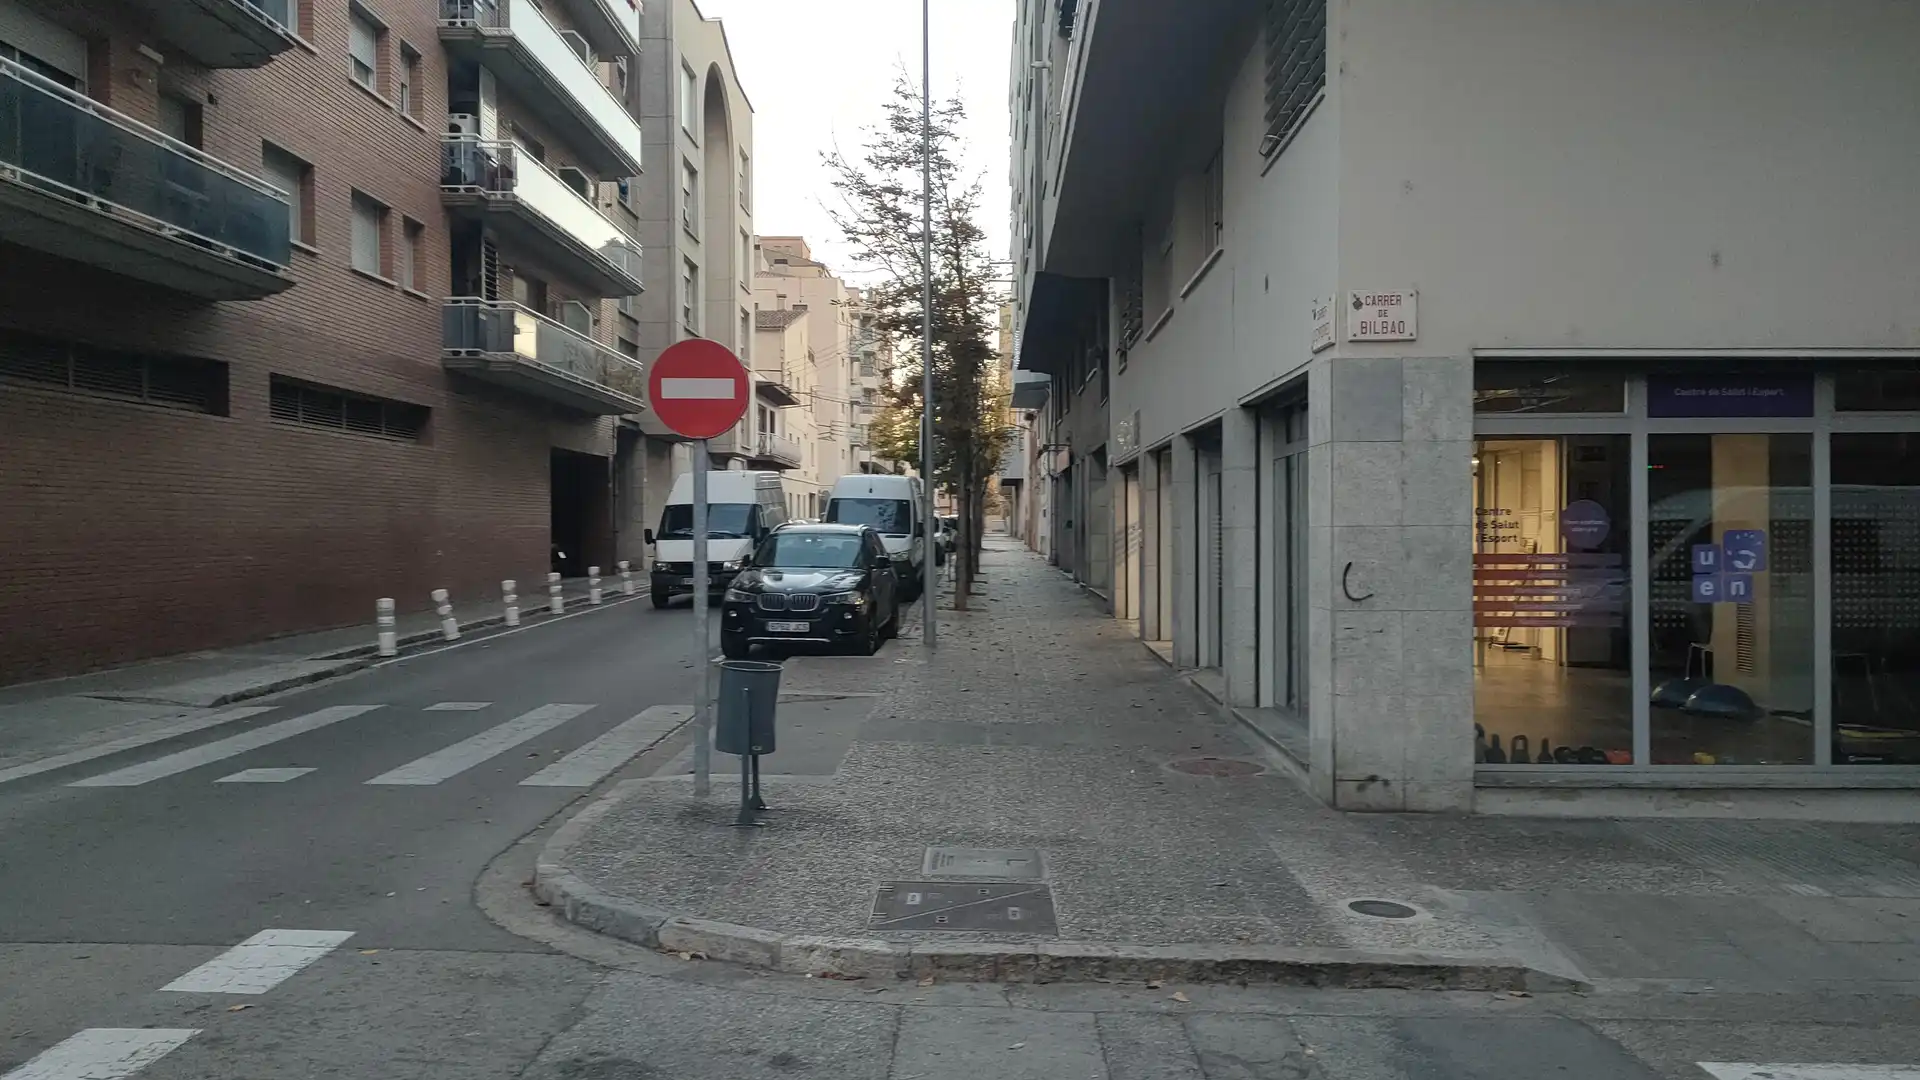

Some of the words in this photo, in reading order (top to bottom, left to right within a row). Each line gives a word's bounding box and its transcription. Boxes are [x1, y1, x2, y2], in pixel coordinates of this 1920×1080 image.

[1364, 294, 1402, 306] CARRER
[1377, 309, 1389, 318] DE
[1360, 320, 1406, 335] BILBAO
[1673, 387, 1706, 396] Centre
[1475, 507, 1512, 516] Centre
[1490, 520, 1520, 529] Salut
[1480, 533, 1519, 544] Esport
